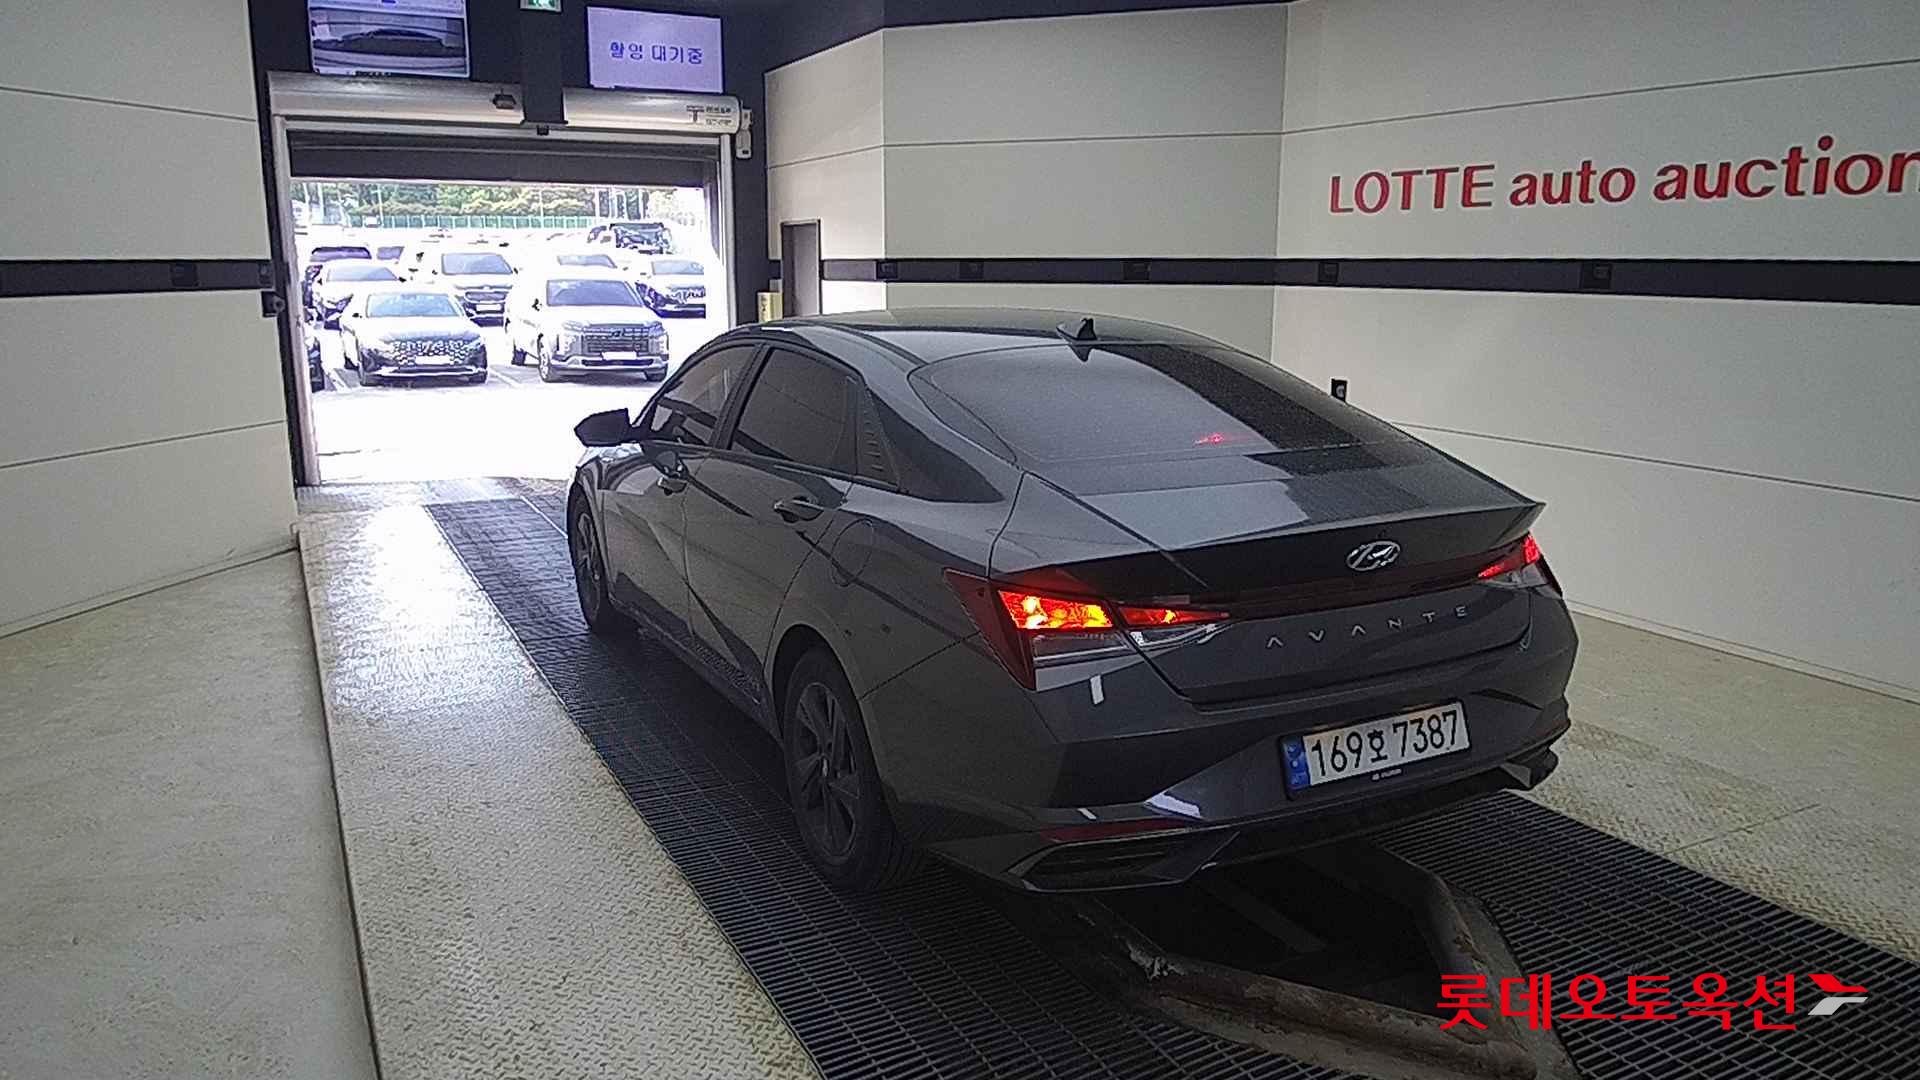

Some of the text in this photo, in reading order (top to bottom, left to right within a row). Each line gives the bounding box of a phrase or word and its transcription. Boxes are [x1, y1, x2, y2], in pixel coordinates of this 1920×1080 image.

[652, 45, 703, 64] 대기중
[1330, 164, 1495, 213] LOTTE
[1509, 160, 1636, 206] auto
[1267, 606, 1467, 649] AVANTE
